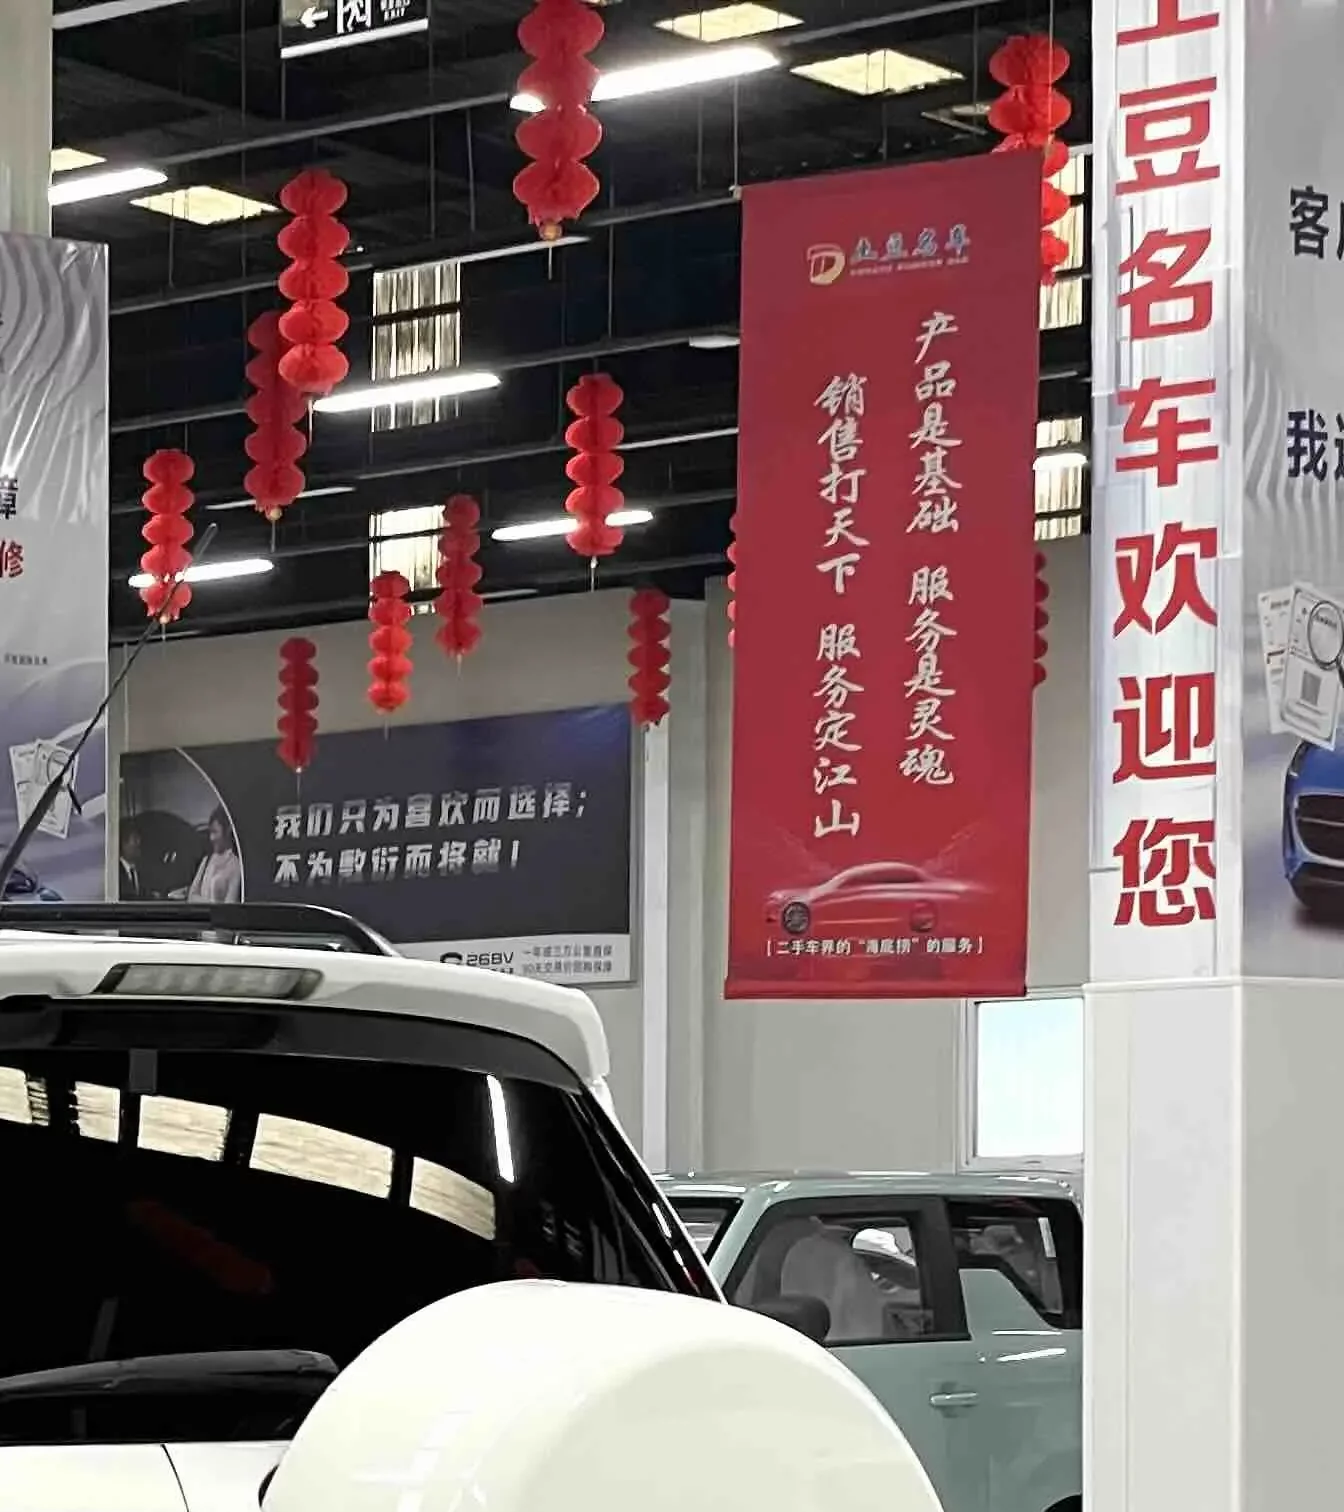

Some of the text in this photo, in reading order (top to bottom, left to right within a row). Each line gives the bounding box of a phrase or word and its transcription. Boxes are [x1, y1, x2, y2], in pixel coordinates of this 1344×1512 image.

[1289, 185, 1344, 260] 客
[906, 311, 962, 533] 产品是基础
[1287, 409, 1344, 482] 我
[813, 372, 869, 838] 销售打天下 服务定江山
[899, 565, 957, 785] 服务是灵魂
